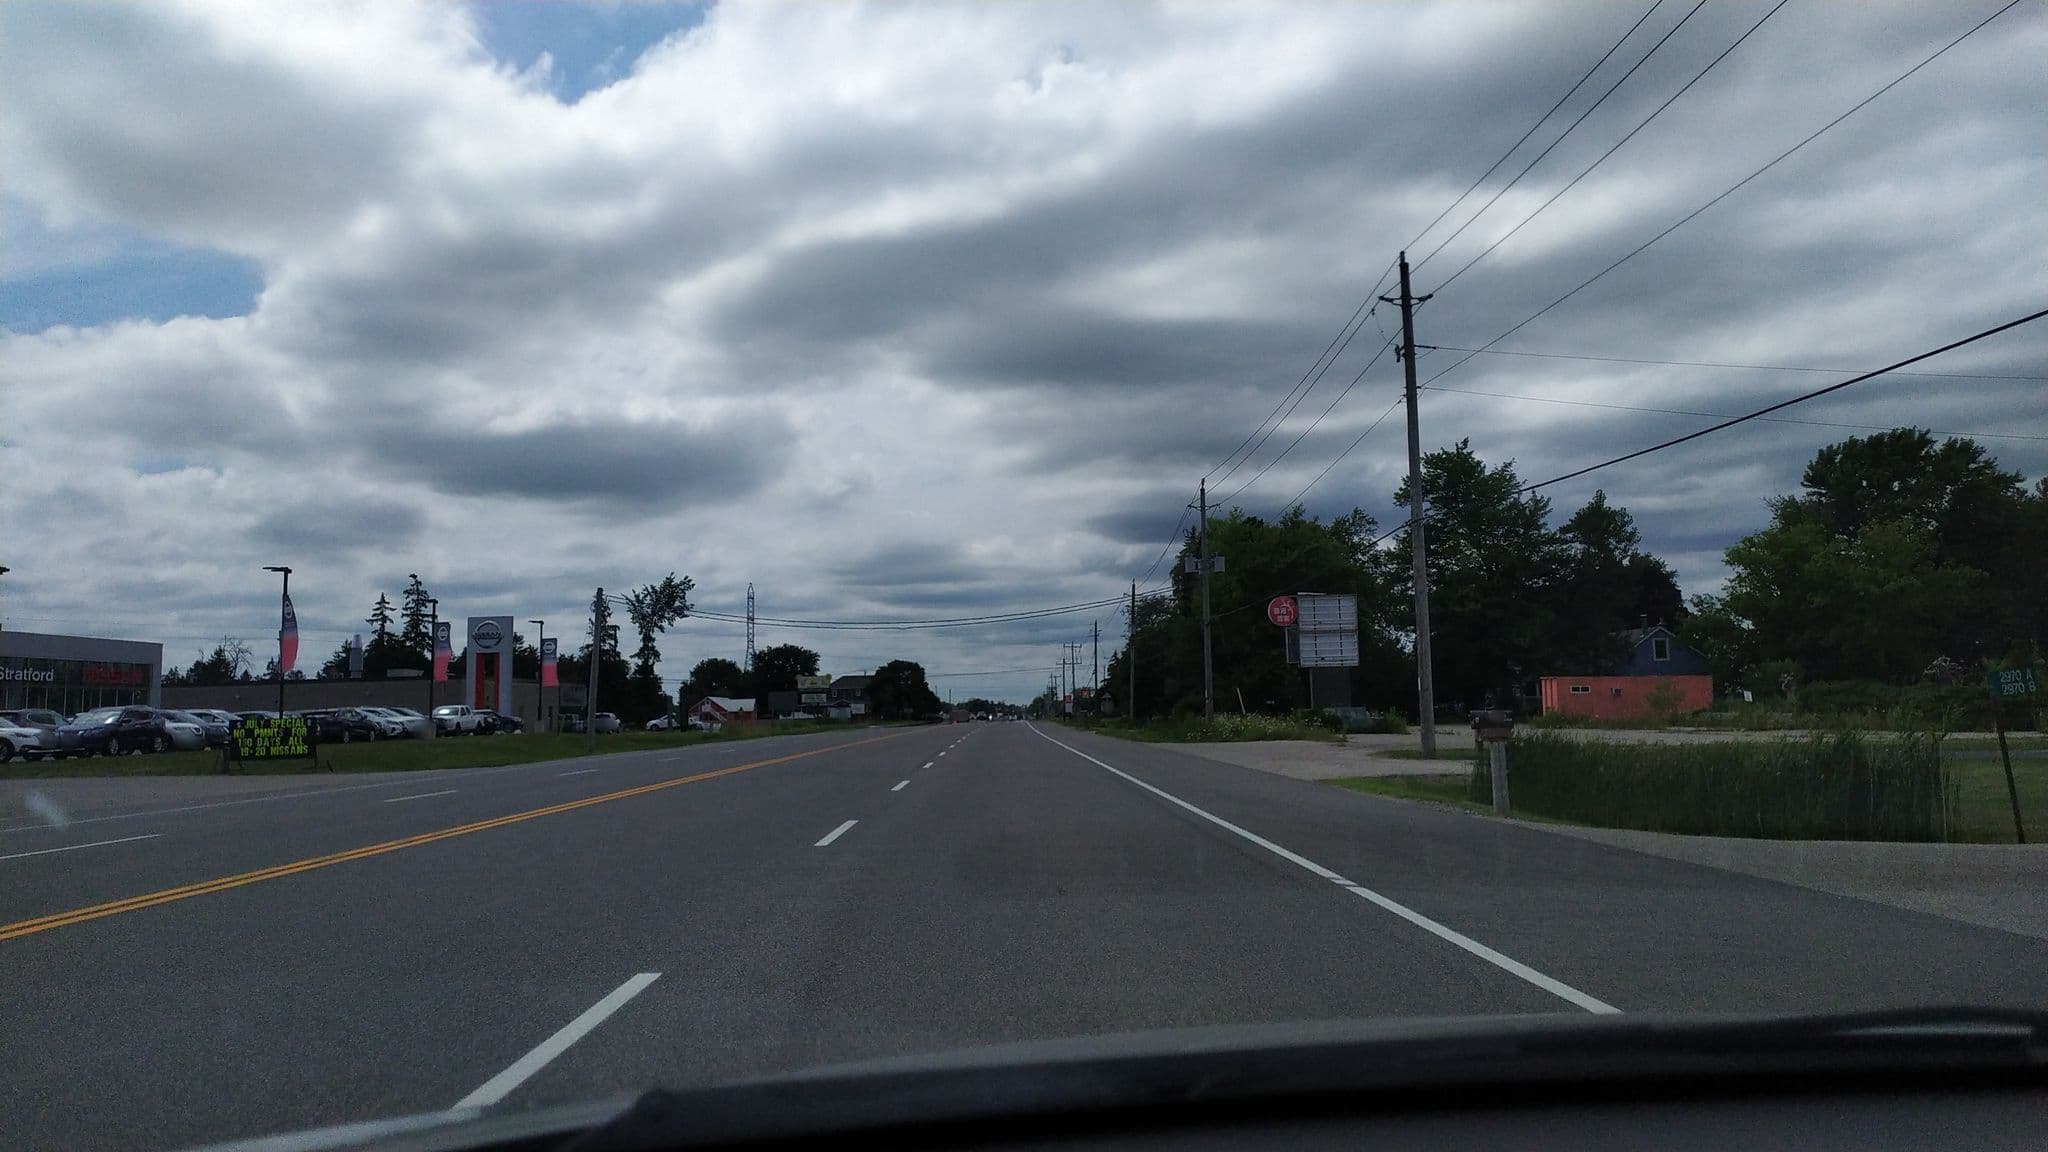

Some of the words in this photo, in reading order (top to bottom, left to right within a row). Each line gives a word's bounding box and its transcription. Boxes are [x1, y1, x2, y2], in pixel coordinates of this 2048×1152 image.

[2026, 668, 2033, 680] A
[245, 719, 265, 729] JULY
[270, 718, 306, 728] SPECIAL
[233, 729, 245, 738] NO
[254, 728, 284, 737] PMNTS
[291, 727, 307, 737] FOR
[257, 737, 281, 747] DAYS
[288, 737, 304, 745] ALL
[270, 745, 309, 756] NISSANS
